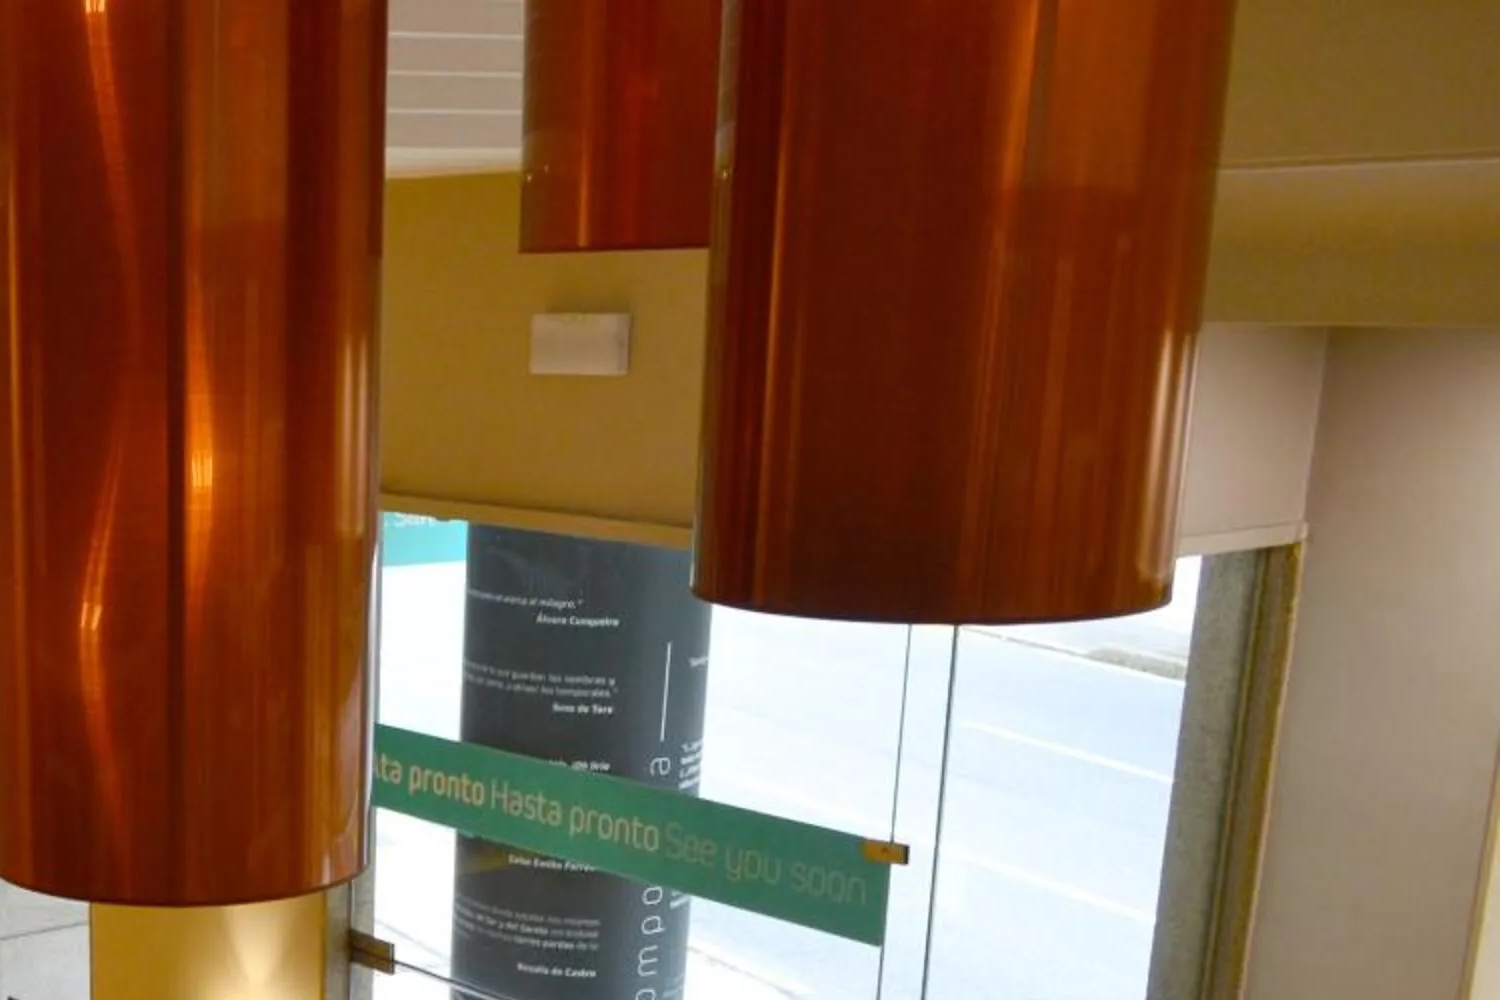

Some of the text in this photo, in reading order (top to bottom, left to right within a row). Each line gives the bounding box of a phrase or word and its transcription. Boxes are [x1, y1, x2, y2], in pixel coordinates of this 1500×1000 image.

[408, 764, 486, 807] pronto
[490, 777, 563, 827] Hasta
[568, 803, 660, 852] pronto
[664, 821, 718, 868] See
[724, 846, 783, 885] you
[790, 861, 867, 906] soon
